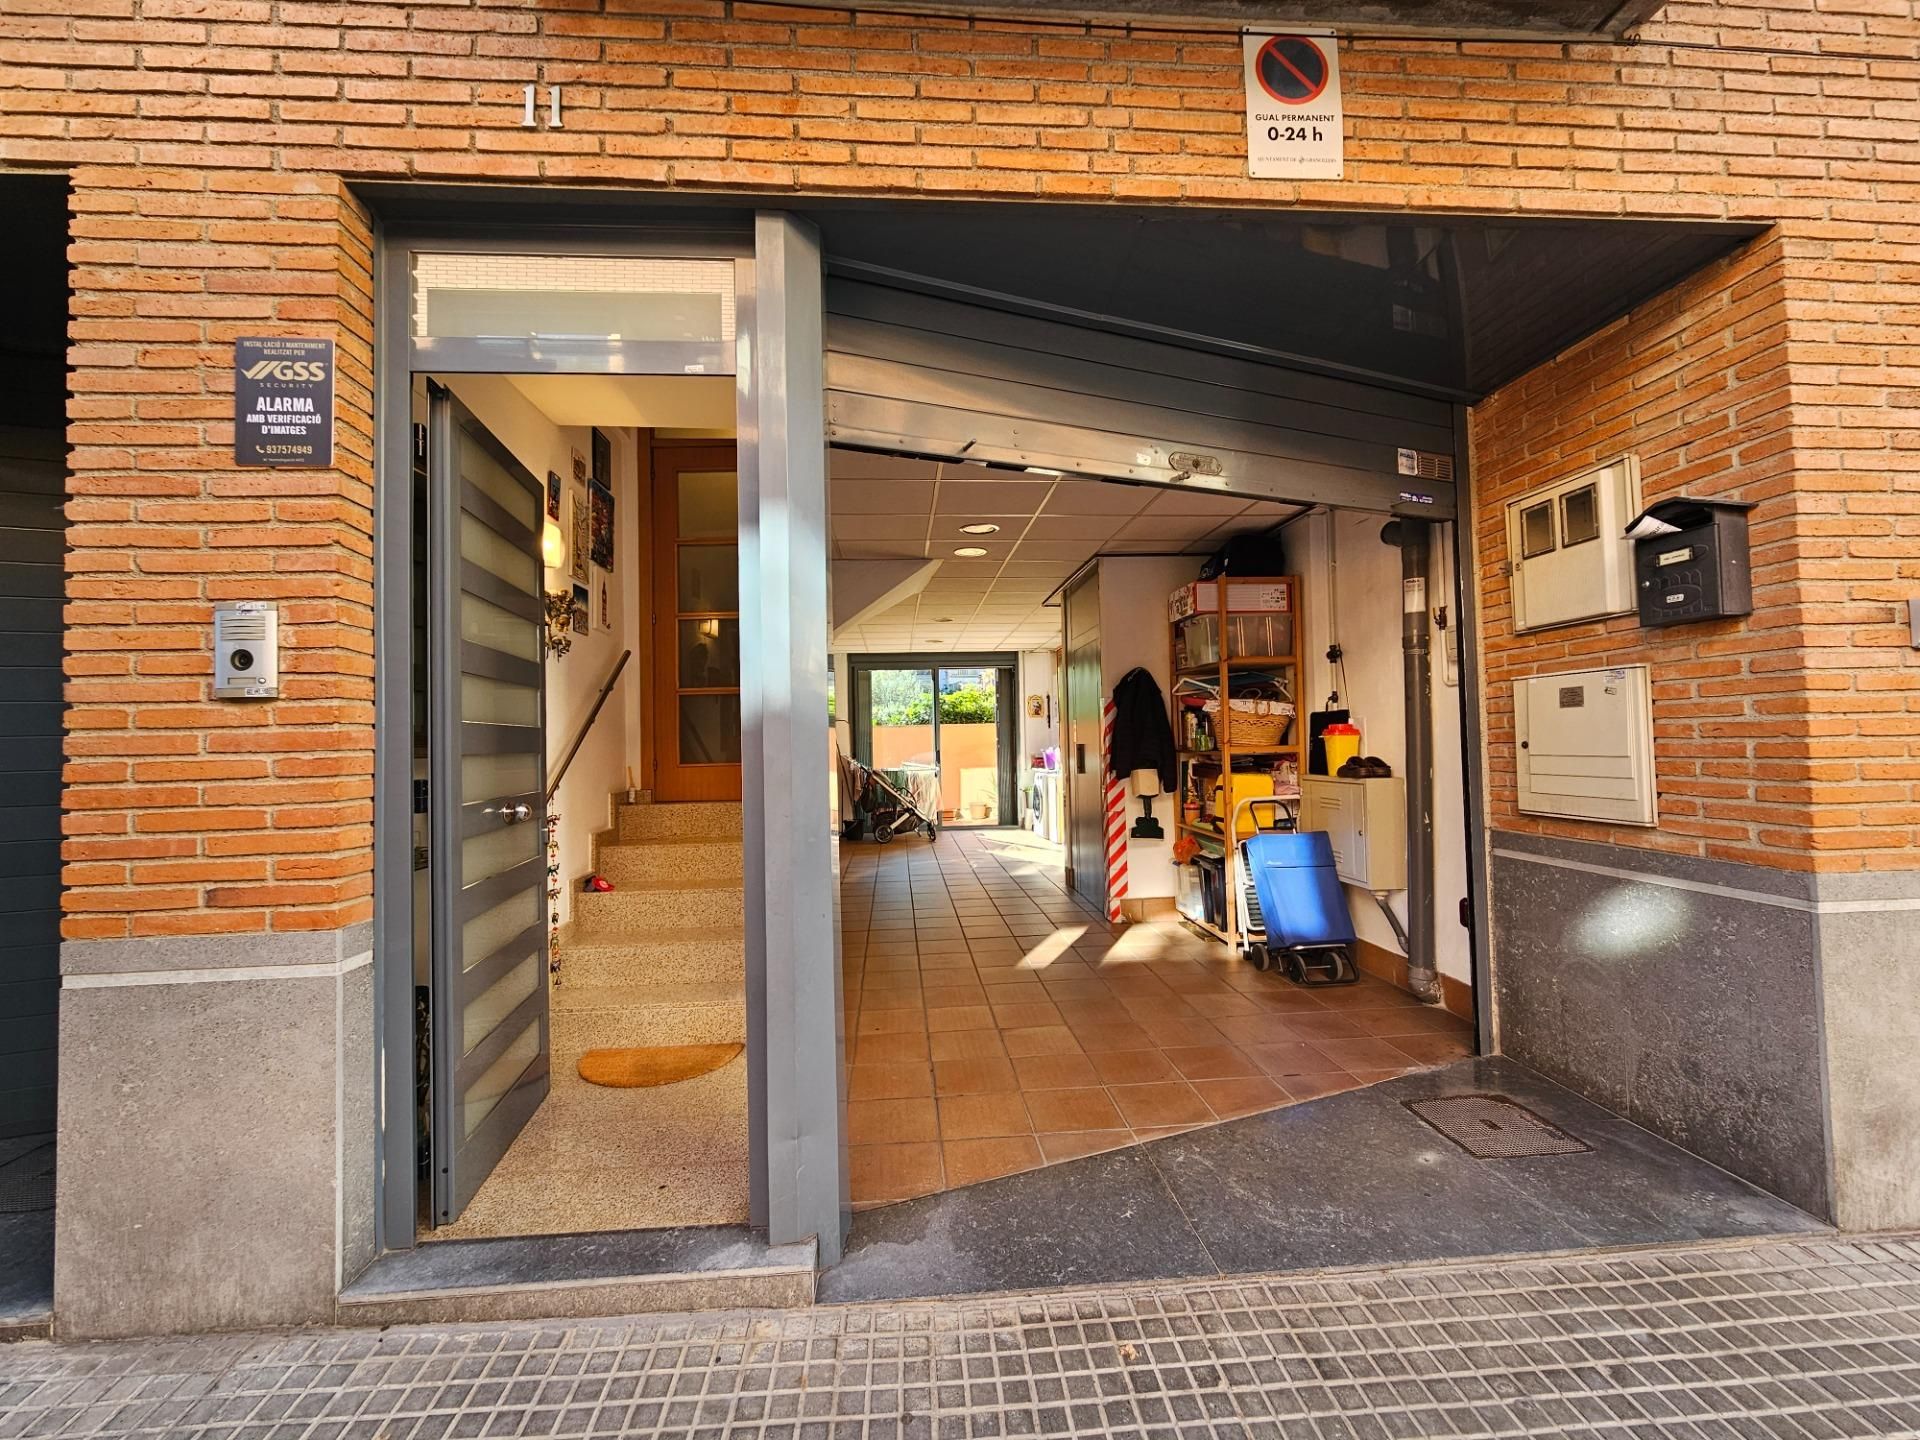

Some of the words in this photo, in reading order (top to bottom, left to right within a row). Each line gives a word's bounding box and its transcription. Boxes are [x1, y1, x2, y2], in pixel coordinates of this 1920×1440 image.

[521, 84, 564, 127] 11
[1255, 113, 1279, 122] GUAL
[1281, 114, 1335, 122] PERMANENT
[1267, 126, 1307, 142] 0-24
[1312, 126, 1323, 142] h
[272, 360, 326, 382] GSS
[256, 396, 314, 413] ALARMA
[246, 414, 265, 423] AMB
[266, 413, 322, 424] VERIFICACIÓ
[261, 425, 307, 435] D'IMATGES
[266, 444, 312, 455] 937574949
